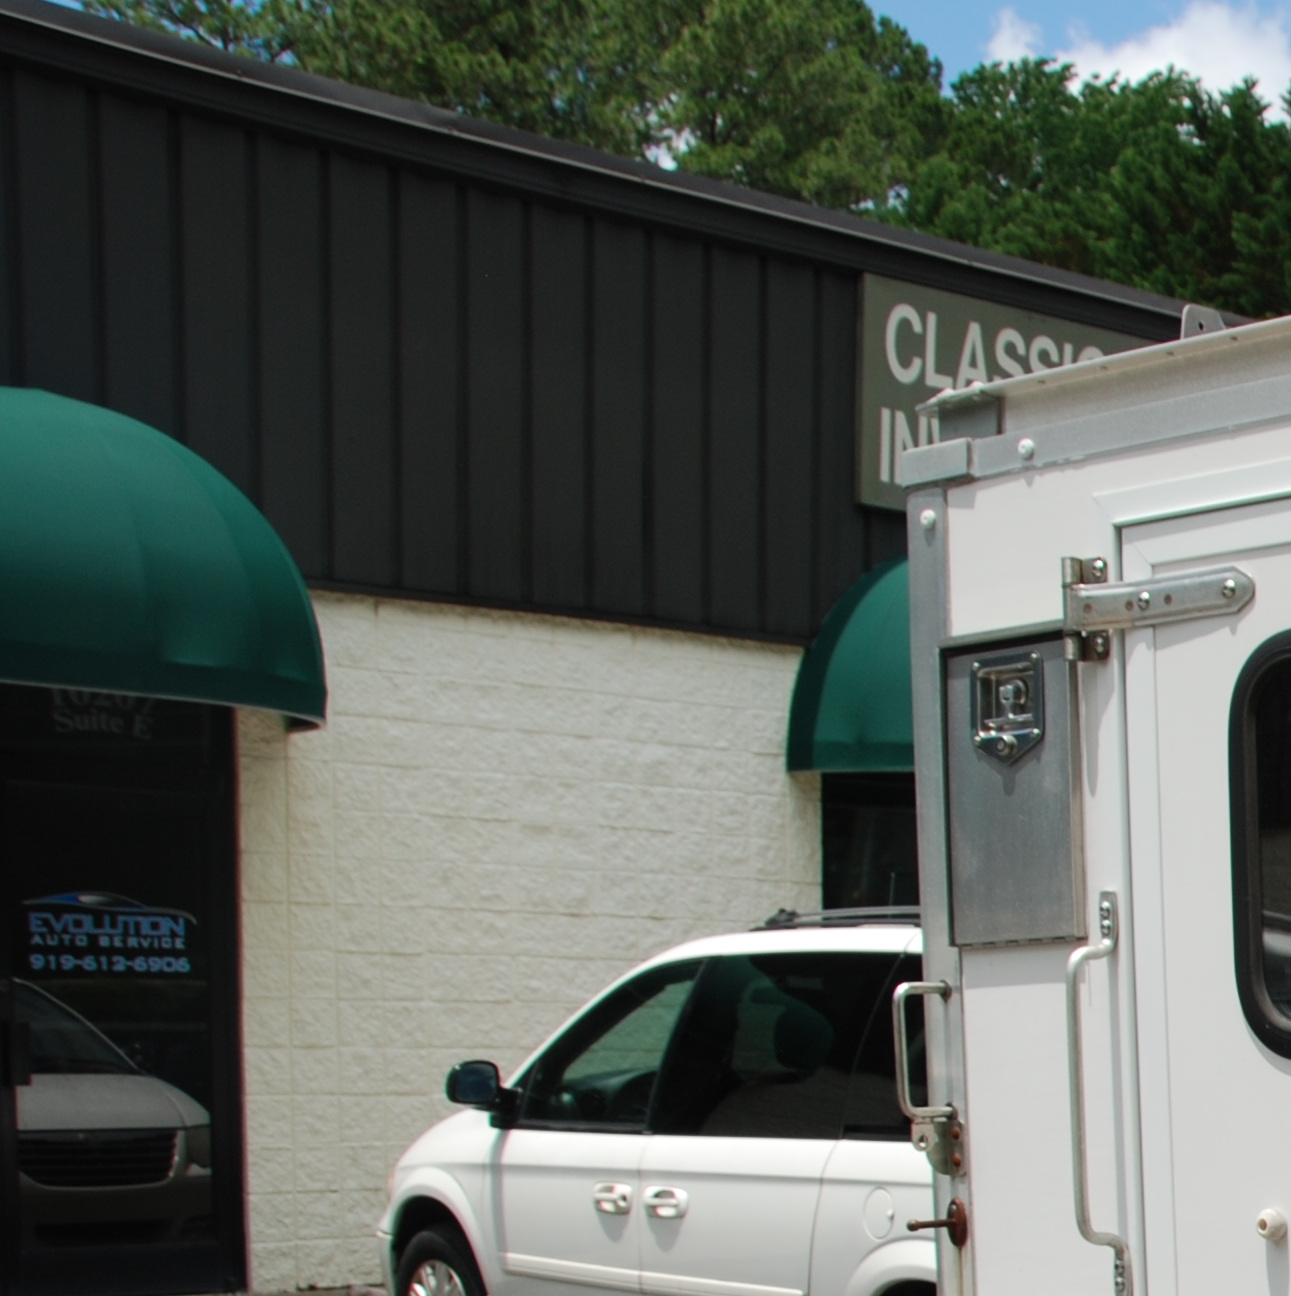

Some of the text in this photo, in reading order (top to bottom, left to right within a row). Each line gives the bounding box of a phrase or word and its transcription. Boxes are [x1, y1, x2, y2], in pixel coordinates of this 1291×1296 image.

[880, 408, 940, 484] IN
[54, 707, 153, 739] Suite E
[29, 913, 186, 936] EVOLUTION
[31, 934, 186, 949] AUTO SERVICE
[29, 954, 190, 973] 919-612-6906
